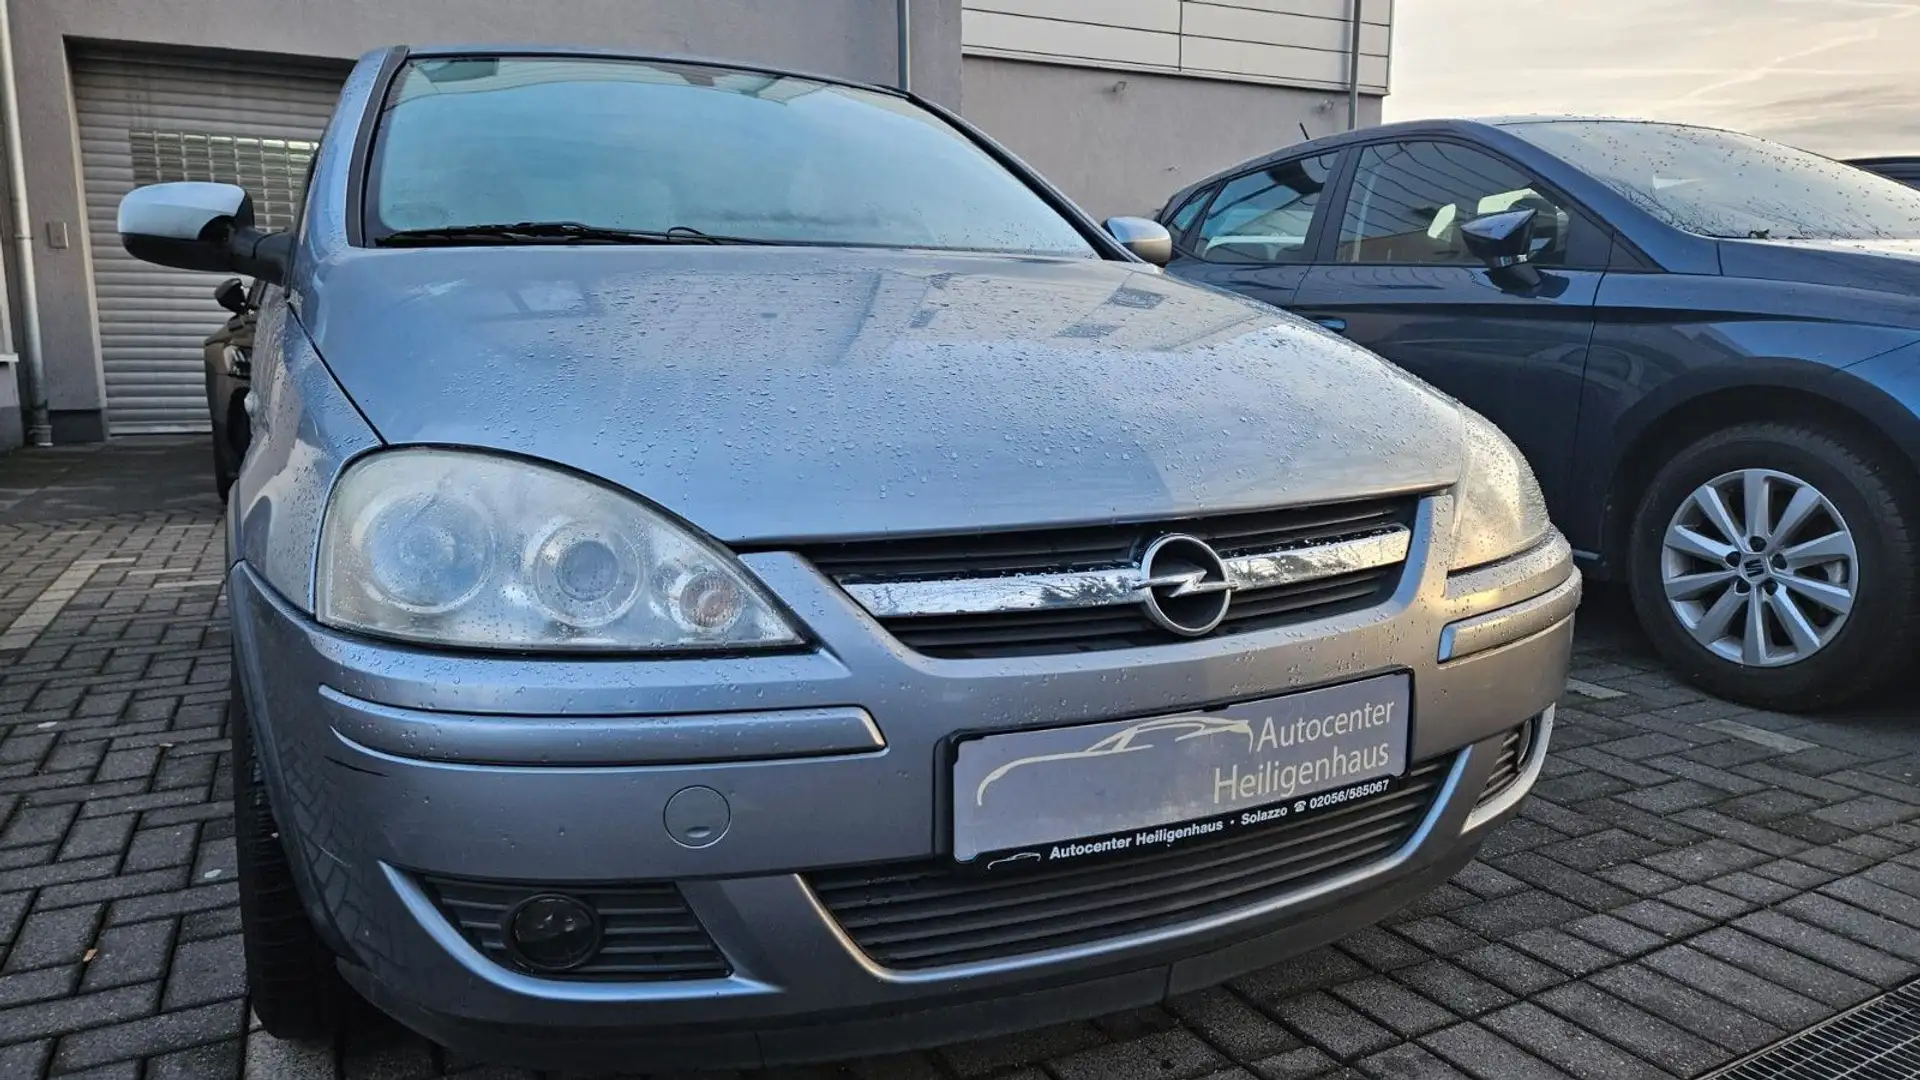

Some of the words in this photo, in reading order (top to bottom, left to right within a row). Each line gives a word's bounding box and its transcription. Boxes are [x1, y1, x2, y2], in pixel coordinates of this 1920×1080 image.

[1257, 699, 1394, 752] Autocenter
[1213, 741, 1389, 804] Heiligenhaus
[1049, 836, 1132, 860] Autocenter
[1136, 819, 1223, 846] Heiligenhaus
[1241, 805, 1288, 826] Solazzo
[1309, 779, 1389, 809] 02056/585067
